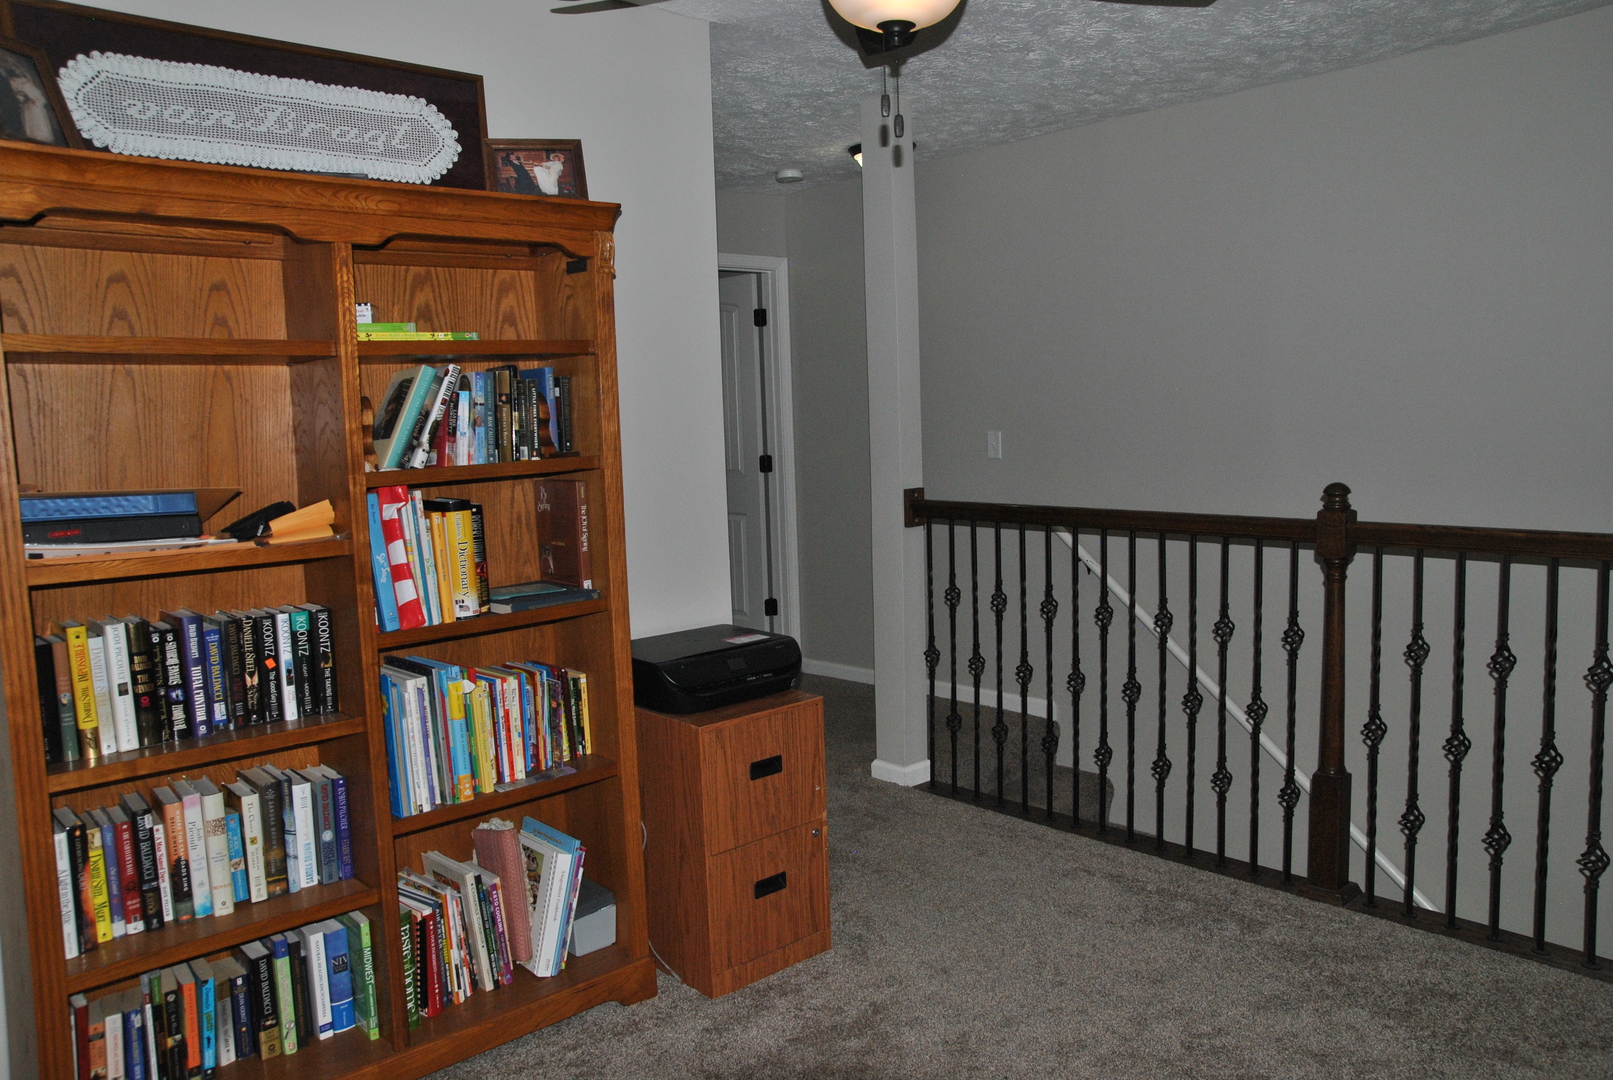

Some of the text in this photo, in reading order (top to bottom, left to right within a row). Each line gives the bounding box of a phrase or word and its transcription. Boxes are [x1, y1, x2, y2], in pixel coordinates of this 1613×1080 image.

[376, 553, 385, 563] Six
[455, 512, 471, 598] Children's Dictionary
[580, 532, 588, 552] Signing
[380, 567, 390, 583] Seuss
[242, 619, 256, 673] DANIELLE STEEL
[263, 622, 274, 656] KOONTZ
[281, 620, 292, 655] KOONTZ
[296, 618, 309, 656] KOONTZ
[318, 616, 330, 653] KOONTZ
[74, 643, 89, 683] IMPOSSIBLE
[91, 647, 103, 684] DANIELLE
[112, 627, 126, 681] JODI PICOULT
[209, 642, 220, 664] DAVID
[231, 644, 239, 675] BALDACCI
[137, 674, 149, 684] THE
[191, 665, 207, 722] TOTAL CONTROL
[211, 666, 223, 701] BALDACCI
[80, 686, 93, 723] DANIELLE STEEL
[270, 694, 278, 703] Guy
[248, 814, 256, 834] Choice
[321, 784, 331, 831] DAVID BALDACCI
[338, 787, 348, 830] ROBIN PILCHER
[136, 816, 154, 880] DAVID BALDACCI
[188, 821, 197, 851] Picoult
[227, 832, 235, 857] PICOULT
[270, 828, 278, 850] BROWN
[178, 844, 187, 876] CRAWDADS
[322, 842, 330, 866] GENIUS
[58, 876, 69, 890] Light
[78, 872, 88, 890] GOD
[90, 854, 107, 923] DANIELLE STEEL MALICE
[159, 871, 167, 883] Dave
[553, 870, 566, 922] 5-Ingredient Cookbook
[471, 887, 485, 945] CASSEROLE COOKBOOK
[495, 907, 503, 932] COOKING
[400, 924, 412, 959] taste
[332, 956, 347, 966] NIV
[363, 948, 374, 984] MIDWEST
[259, 959, 271, 1015] DAVID BALDACCI
[319, 984, 327, 1018] ENCYCLOPEDIA
[404, 967, 417, 1013] home
